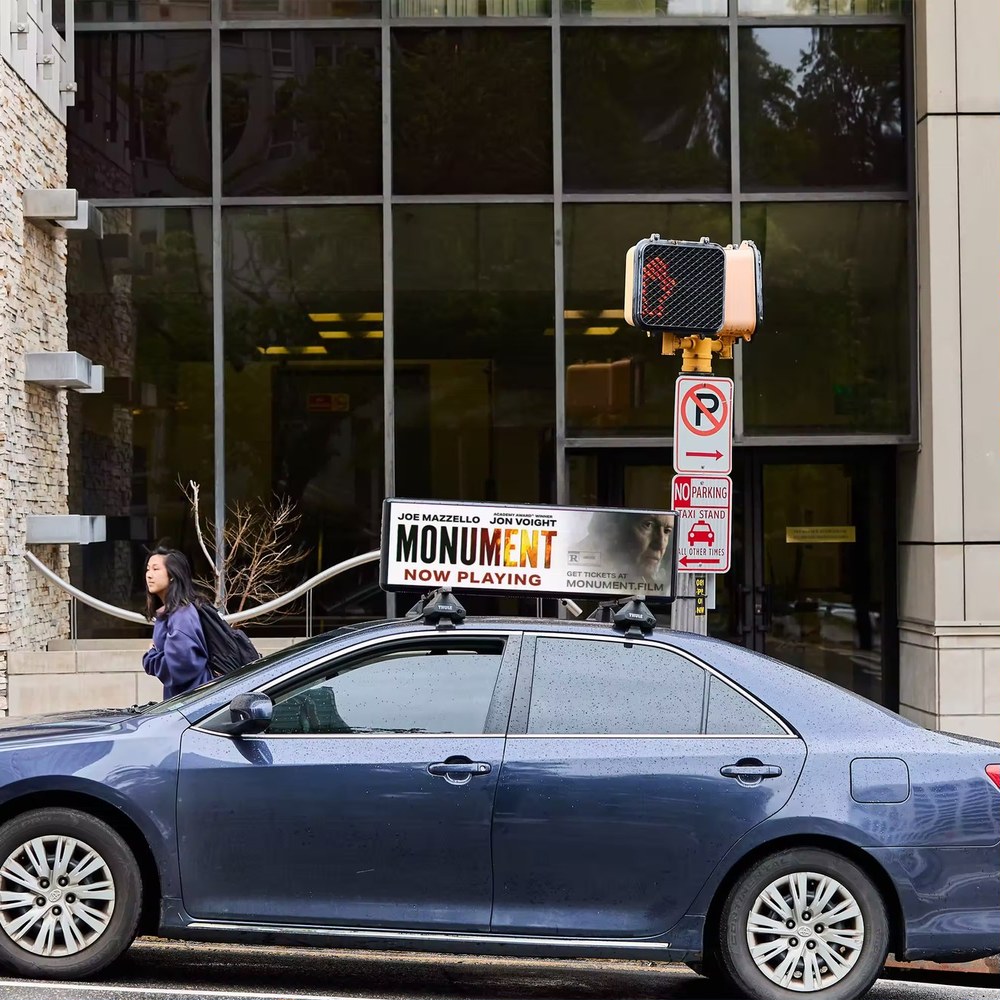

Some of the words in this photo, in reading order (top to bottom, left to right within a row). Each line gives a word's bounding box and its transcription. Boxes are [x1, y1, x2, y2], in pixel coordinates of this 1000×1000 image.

[674, 483, 690, 501] NO
[692, 487, 727, 499] PARKING
[398, 513, 419, 521] JOE
[422, 514, 480, 524] MAZZELLO
[678, 510, 695, 519] TAXI
[699, 510, 725, 519] STAND
[490, 516, 512, 526] JON
[515, 517, 557, 527] VOIGHT
[396, 524, 557, 569] MONUMENT
[689, 548, 706, 556] OTHER
[404, 569, 451, 582] NOW
[458, 571, 541, 586] PLAYING
[567, 579, 664, 592] MONUMENT.FILM
